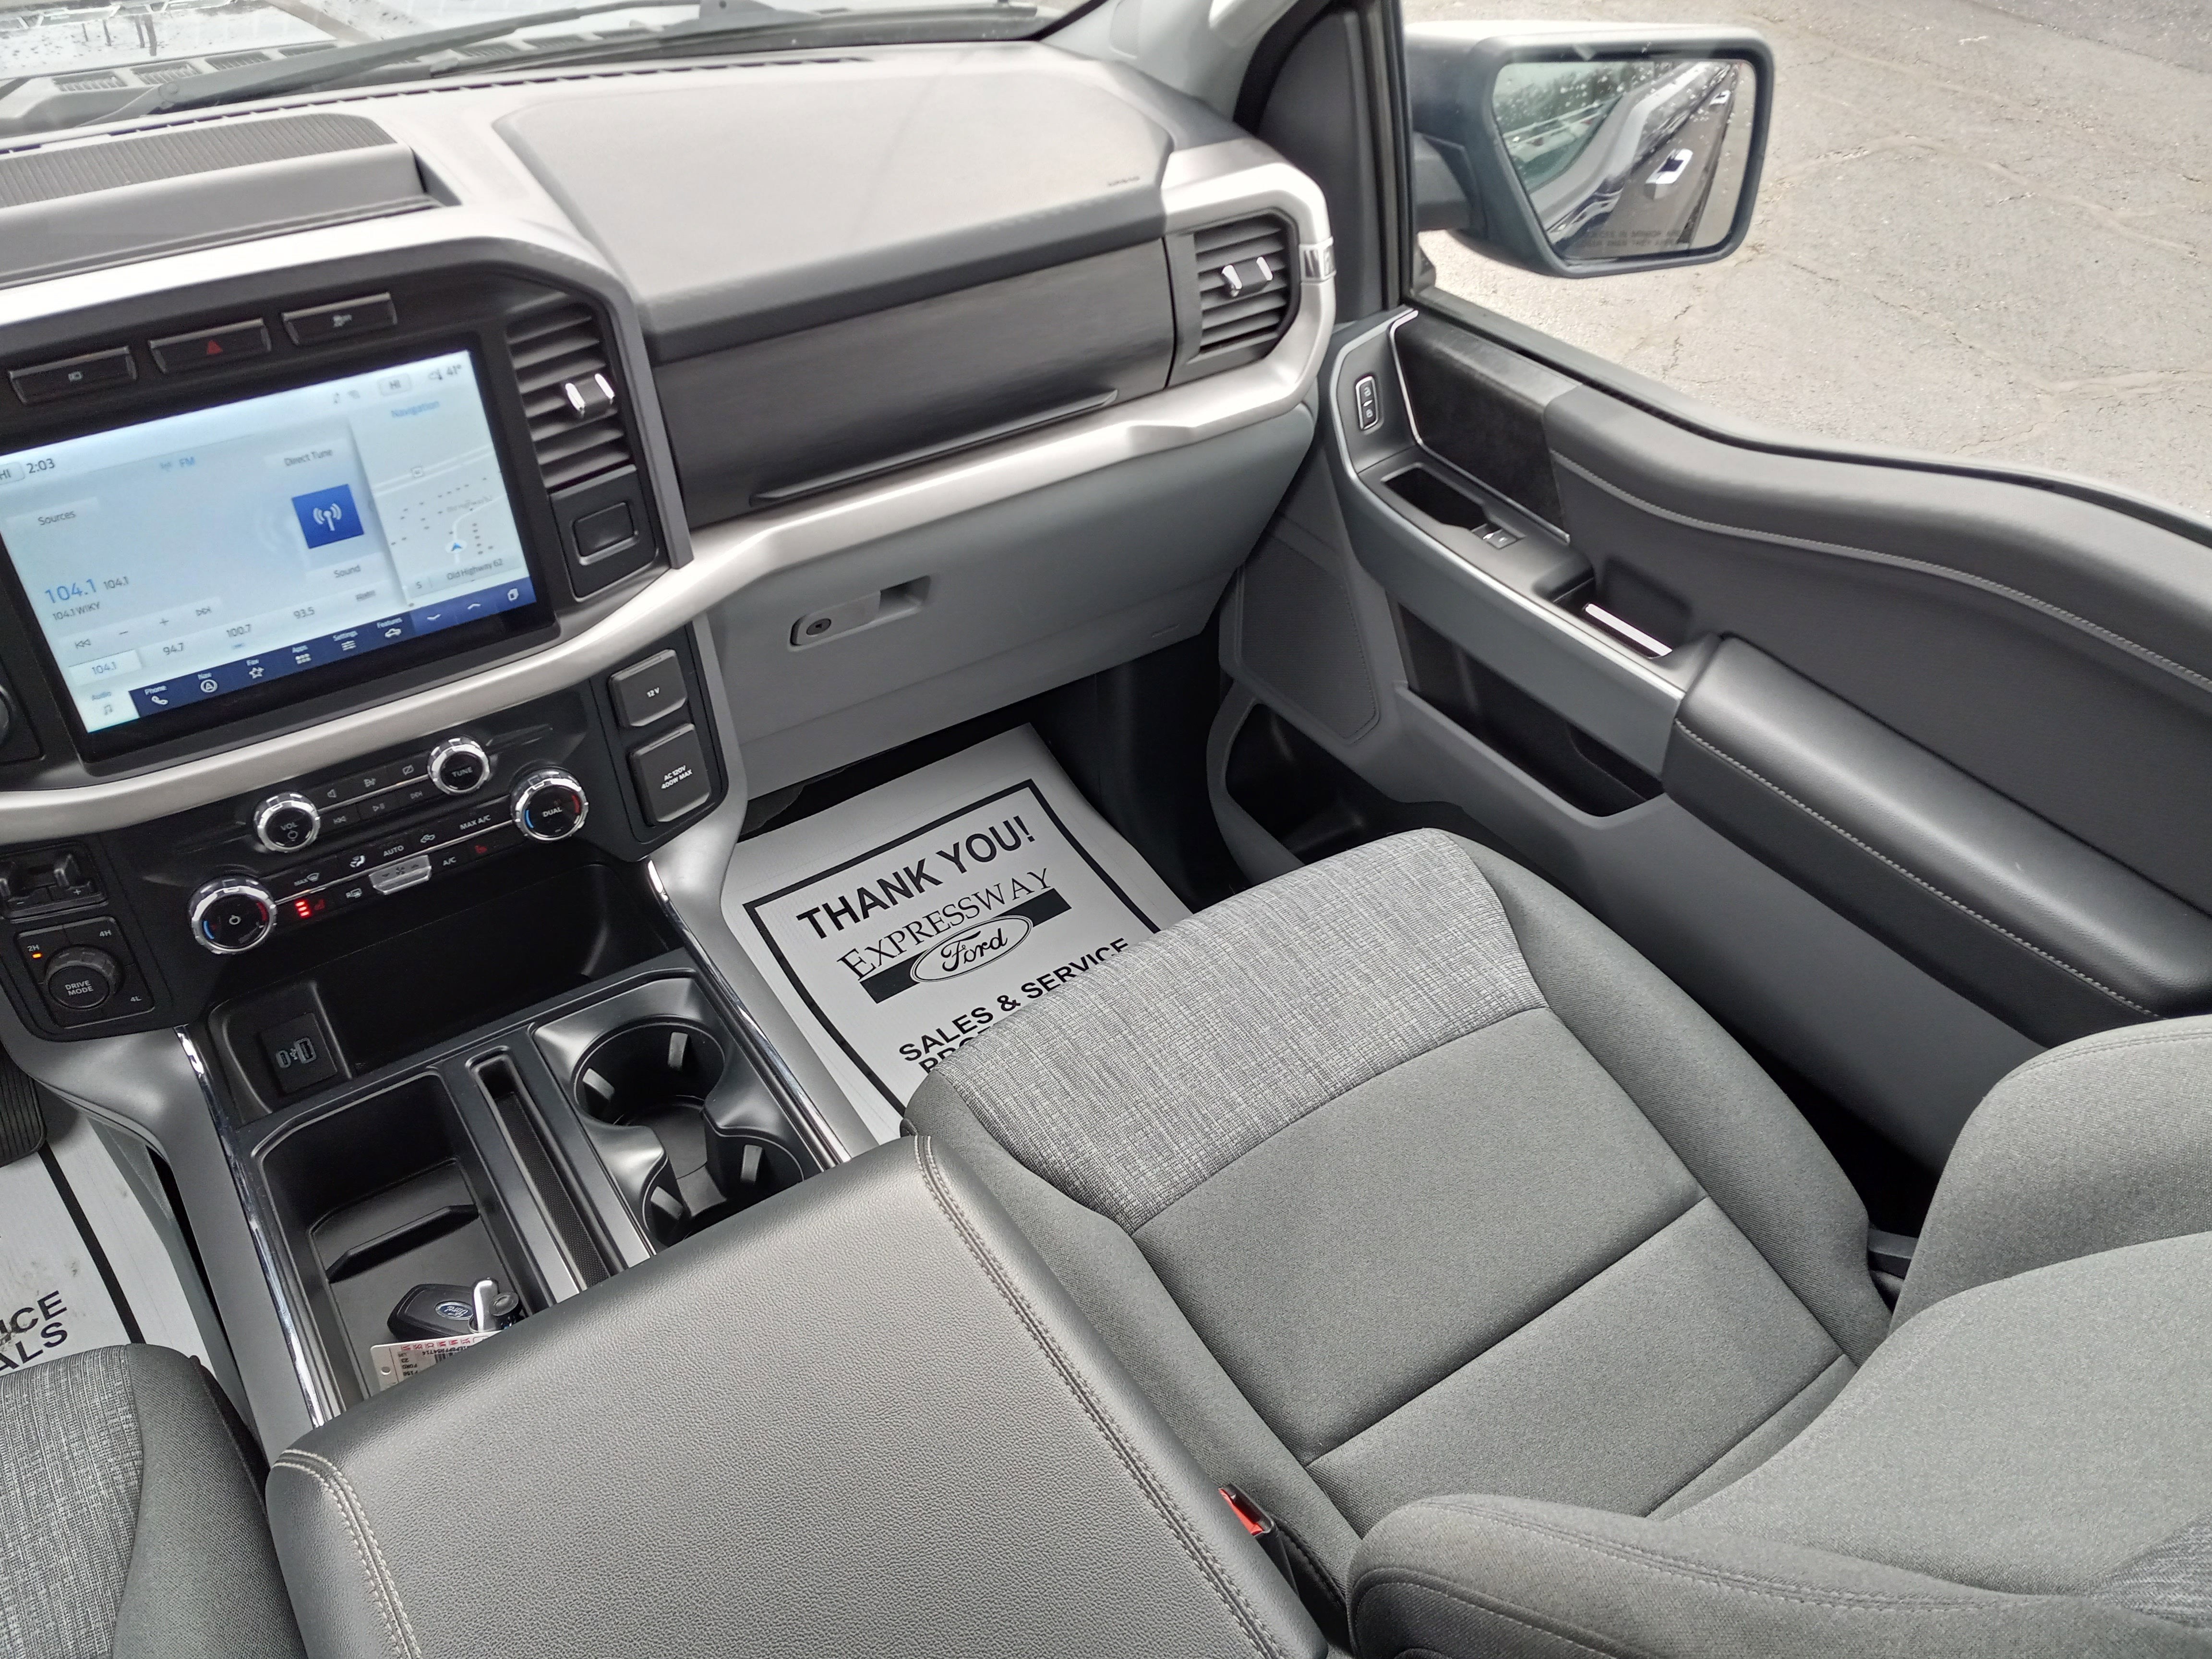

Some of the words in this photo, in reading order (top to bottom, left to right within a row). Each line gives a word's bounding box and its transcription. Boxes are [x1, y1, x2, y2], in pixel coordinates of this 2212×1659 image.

[26, 458, 55, 473] 2:03
[38, 511, 76, 526] Sources
[333, 565, 361, 577] Sound
[45, 578, 96, 603] 104.1
[103, 576, 129, 590] 104.1
[293, 606, 315, 619] 93.5
[91, 661, 117, 674] 104.1
[144, 685, 168, 696] Phone
[451, 766, 473, 778] TUNE
[664, 772, 673, 781] AC
[672, 765, 686, 777] 120V
[661, 778, 679, 789] 400W
[679, 769, 693, 781] MAX
[541, 807, 563, 817] DUAL
[280, 821, 299, 831] VOL
[459, 819, 477, 831] MAX
[477, 814, 492, 825] A/C
[384, 845, 404, 857] AUTO
[443, 857, 457, 866] A/C
[797, 858, 943, 939] THANK
[936, 815, 1035, 874] YOU!
[837, 867, 1053, 981] EXPRESSWAY
[27, 944, 39, 952] 2H
[940, 927, 1008, 973] Ford
[64, 980, 91, 991] DRIVE
[68, 985, 94, 996] MODE
[899, 1007, 993, 1061] SALES
[997, 995, 1021, 1011] &
